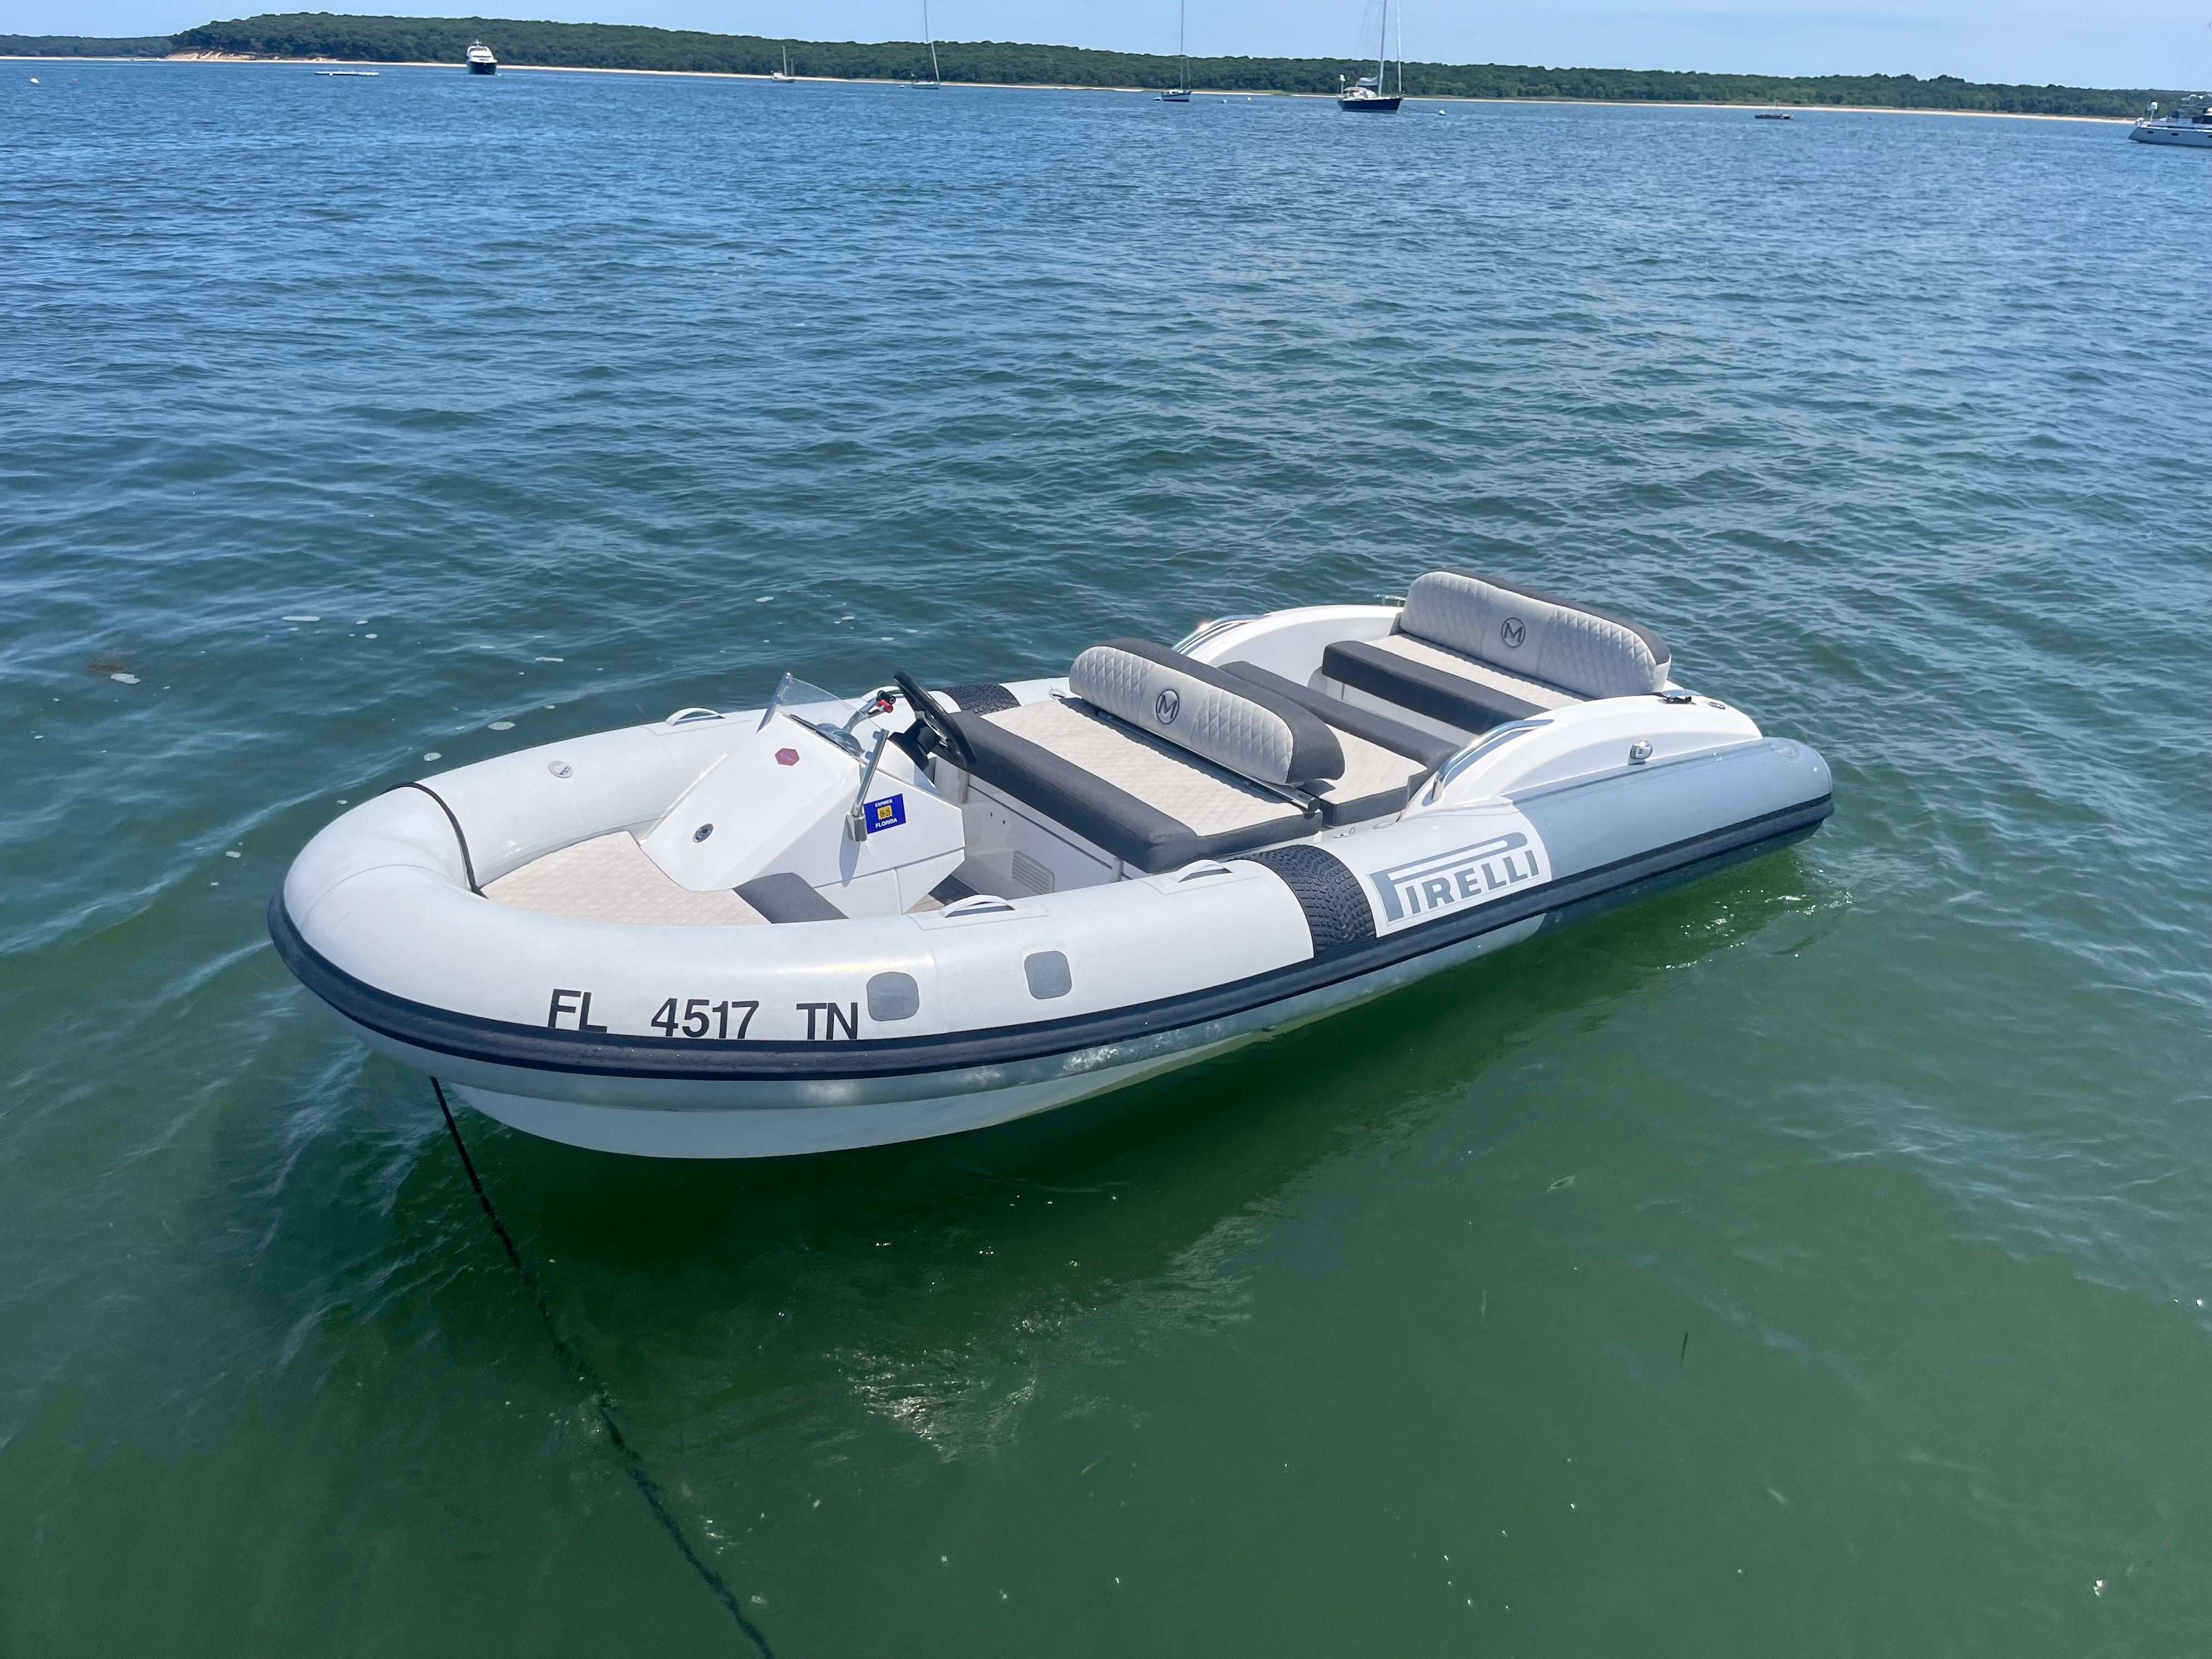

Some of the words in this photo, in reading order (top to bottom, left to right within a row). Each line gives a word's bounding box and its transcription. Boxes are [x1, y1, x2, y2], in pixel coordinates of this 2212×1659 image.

[1504, 623, 1523, 643] M
[1158, 695, 1178, 719] M
[874, 799, 893, 808] EXPIRES
[875, 817, 898, 828] FLORIDA
[1369, 832, 1539, 922] PIRELLI
[548, 989, 607, 1033] FL
[651, 997, 759, 1040] 4517
[796, 1002, 858, 1040] TN
